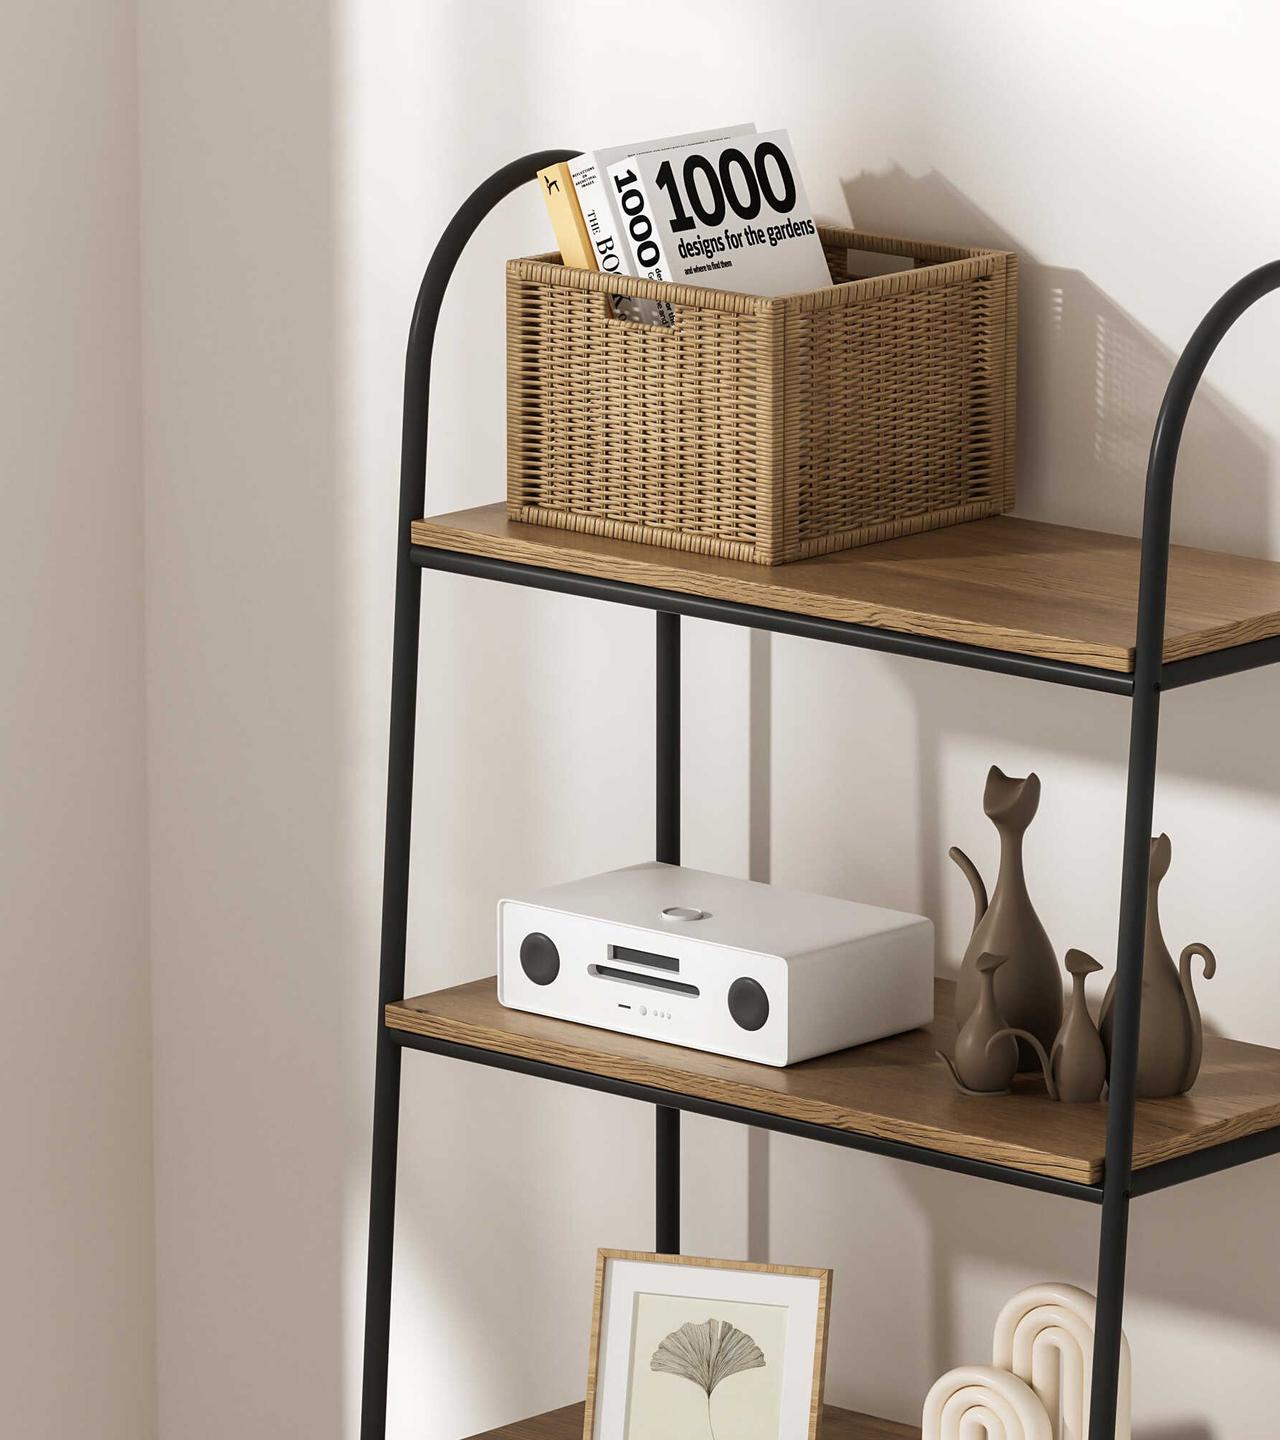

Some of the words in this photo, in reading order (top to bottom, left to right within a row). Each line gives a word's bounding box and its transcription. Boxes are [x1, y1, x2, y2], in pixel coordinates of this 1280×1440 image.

[655, 142, 797, 233] 1000
[587, 209, 601, 235] THE
[614, 169, 660, 268] 1000
[678, 235, 725, 259] designs
[724, 229, 743, 250] for
[744, 225, 765, 246] the
[766, 218, 815, 247] gardens
[684, 266, 693, 275] and
[693, 263, 707, 274] where
[707, 262, 712, 271] to
[711, 260, 721, 270] find
[720, 259, 733, 269] them
